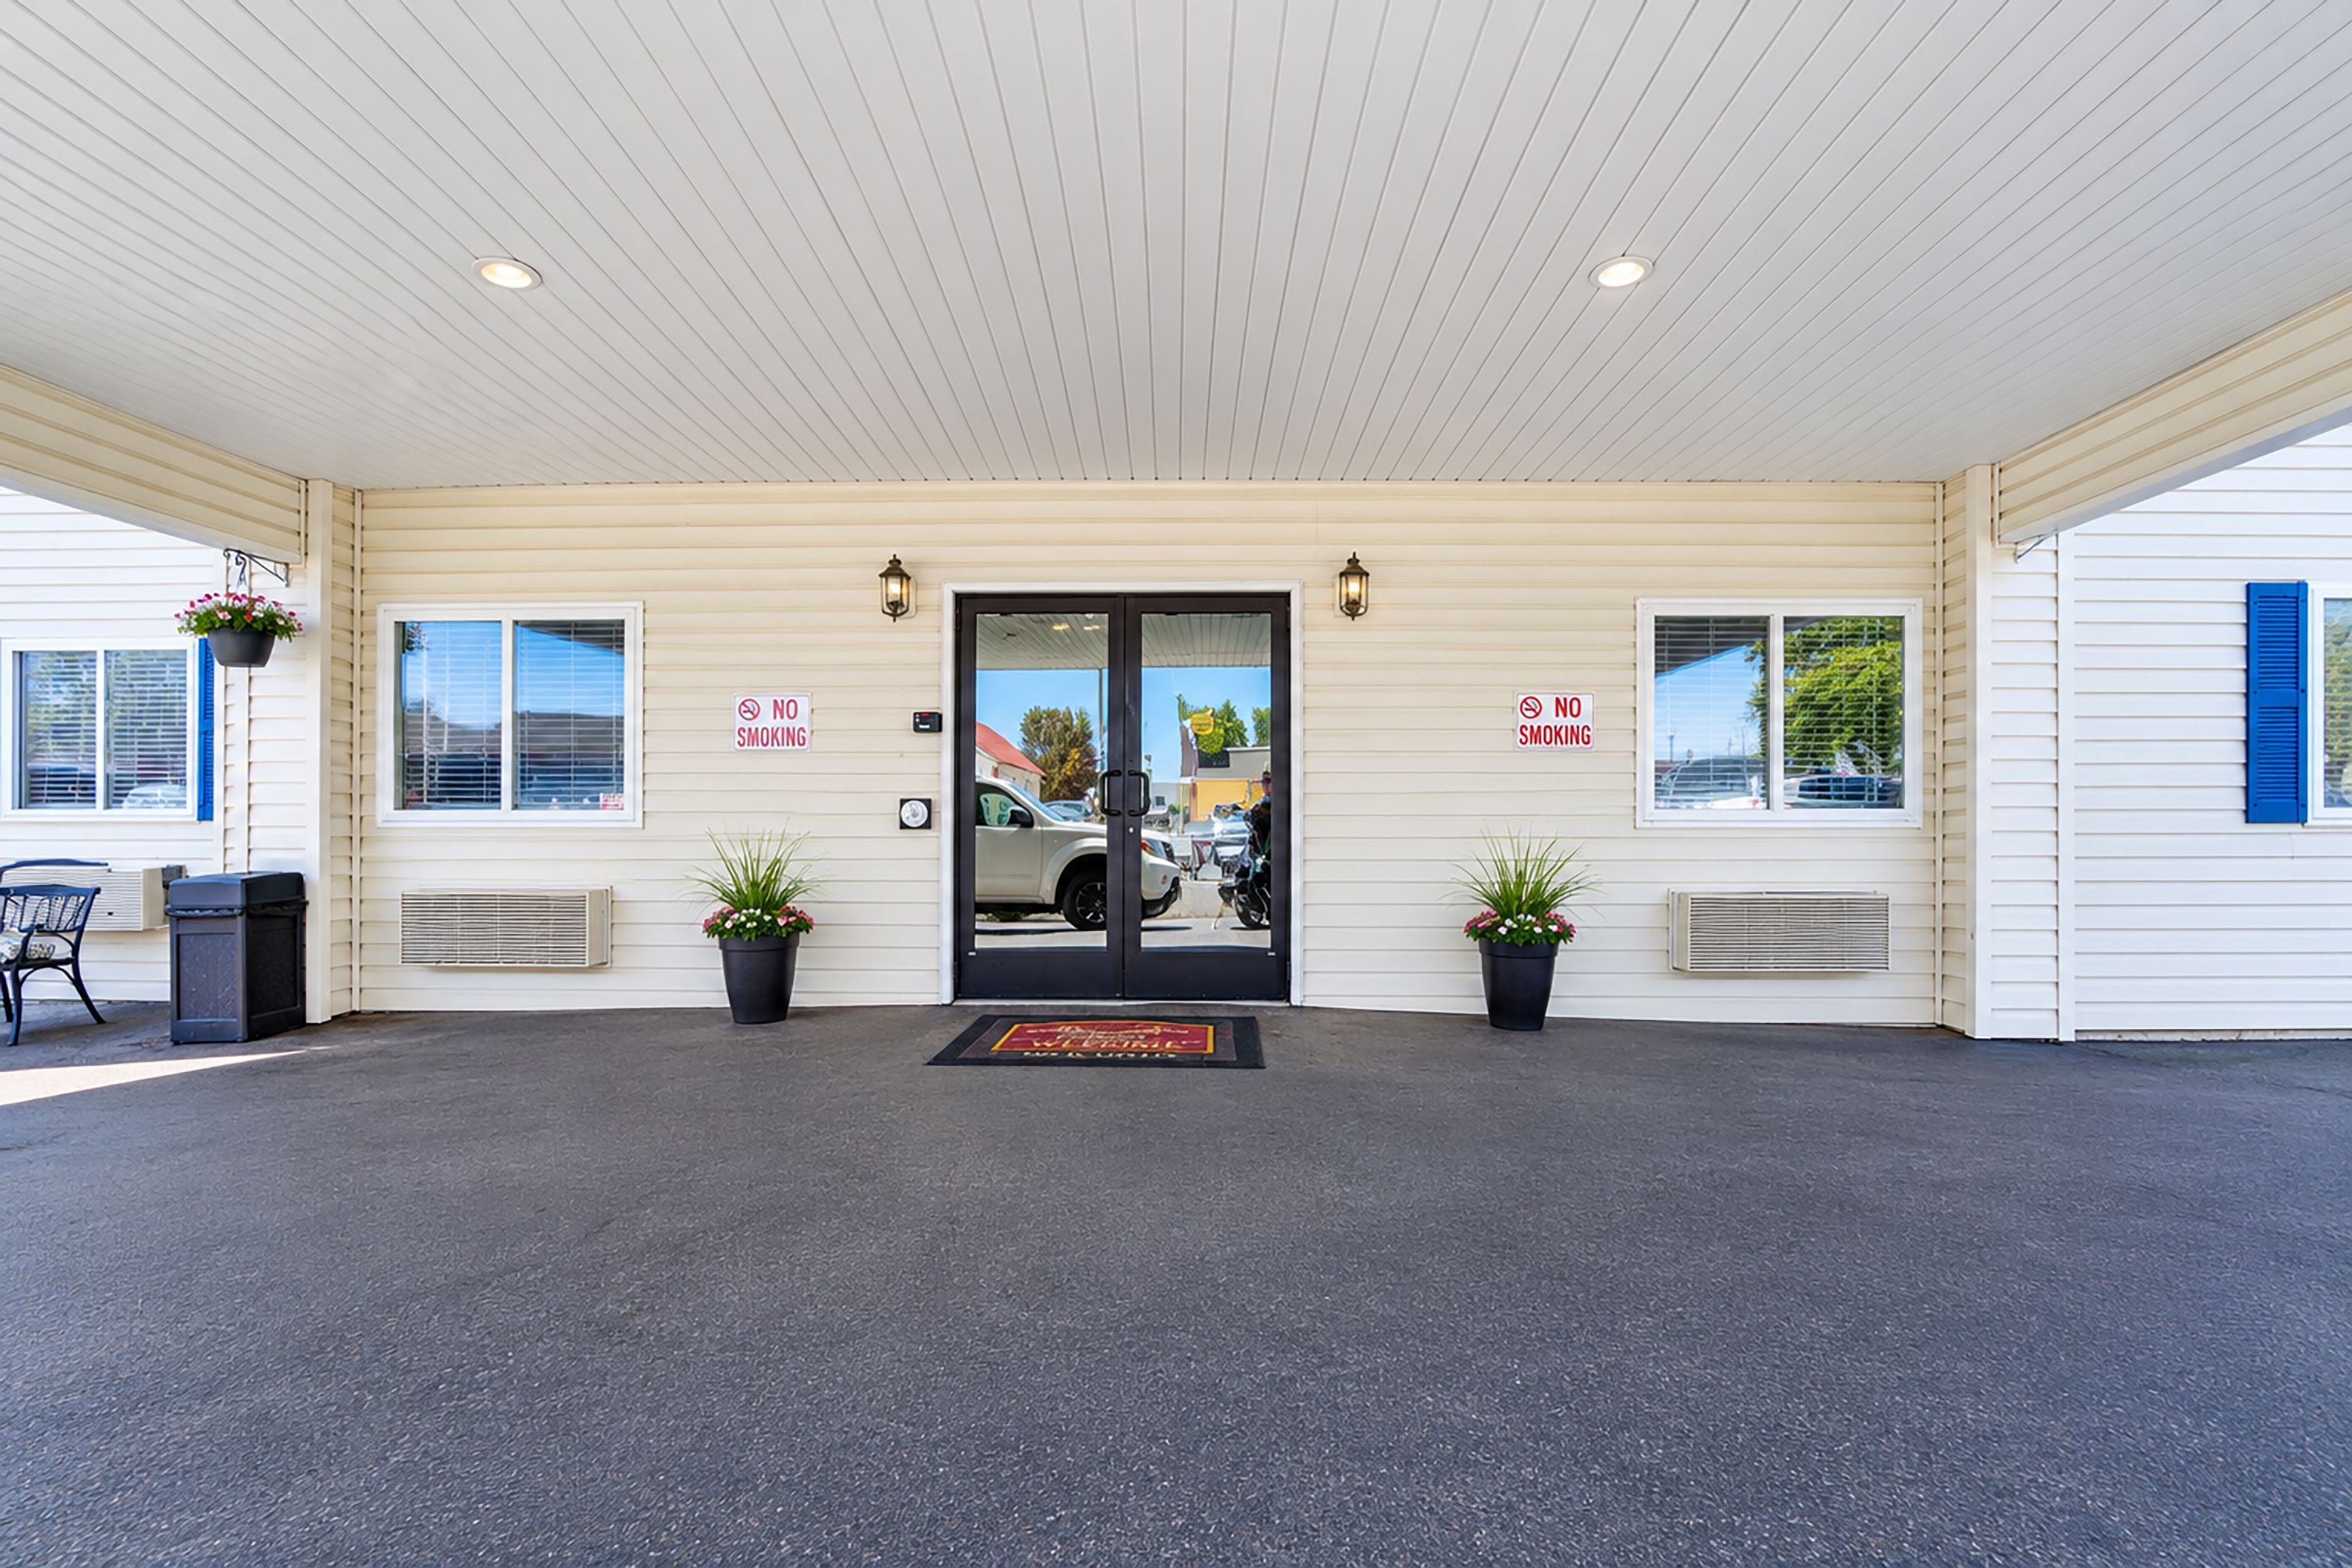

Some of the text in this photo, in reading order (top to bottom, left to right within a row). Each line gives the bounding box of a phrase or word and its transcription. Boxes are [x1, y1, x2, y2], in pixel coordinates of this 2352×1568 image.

[773, 699, 798, 720] NO
[1555, 697, 1581, 718] NO
[737, 727, 806, 747] SMOKING
[1519, 724, 1591, 745] SMOKING
